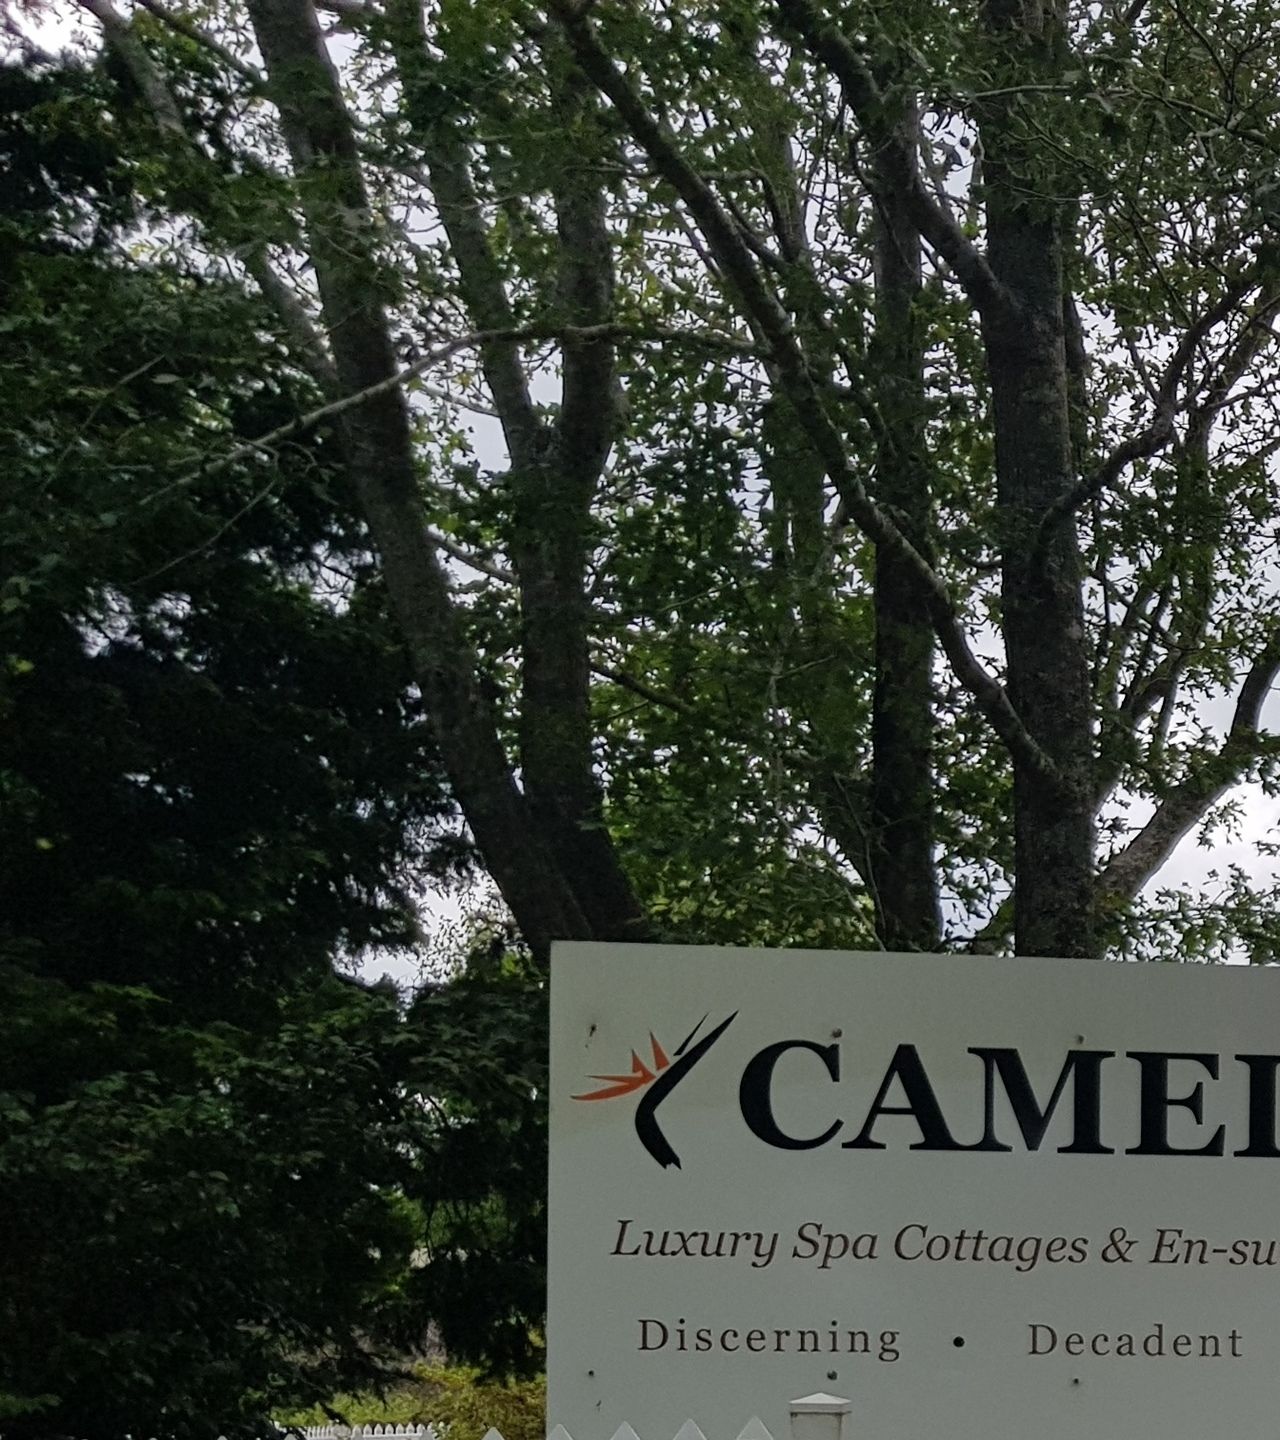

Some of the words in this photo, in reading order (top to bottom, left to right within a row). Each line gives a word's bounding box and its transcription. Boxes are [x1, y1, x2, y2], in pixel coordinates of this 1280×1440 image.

[609, 1219, 779, 1268] Luxury
[791, 1222, 879, 1270] Spa
[893, 1223, 1089, 1273] Cottages
[1100, 1226, 1140, 1264] &
[637, 1318, 901, 1363] Discerning
[1027, 1323, 1243, 1358] Decadent
